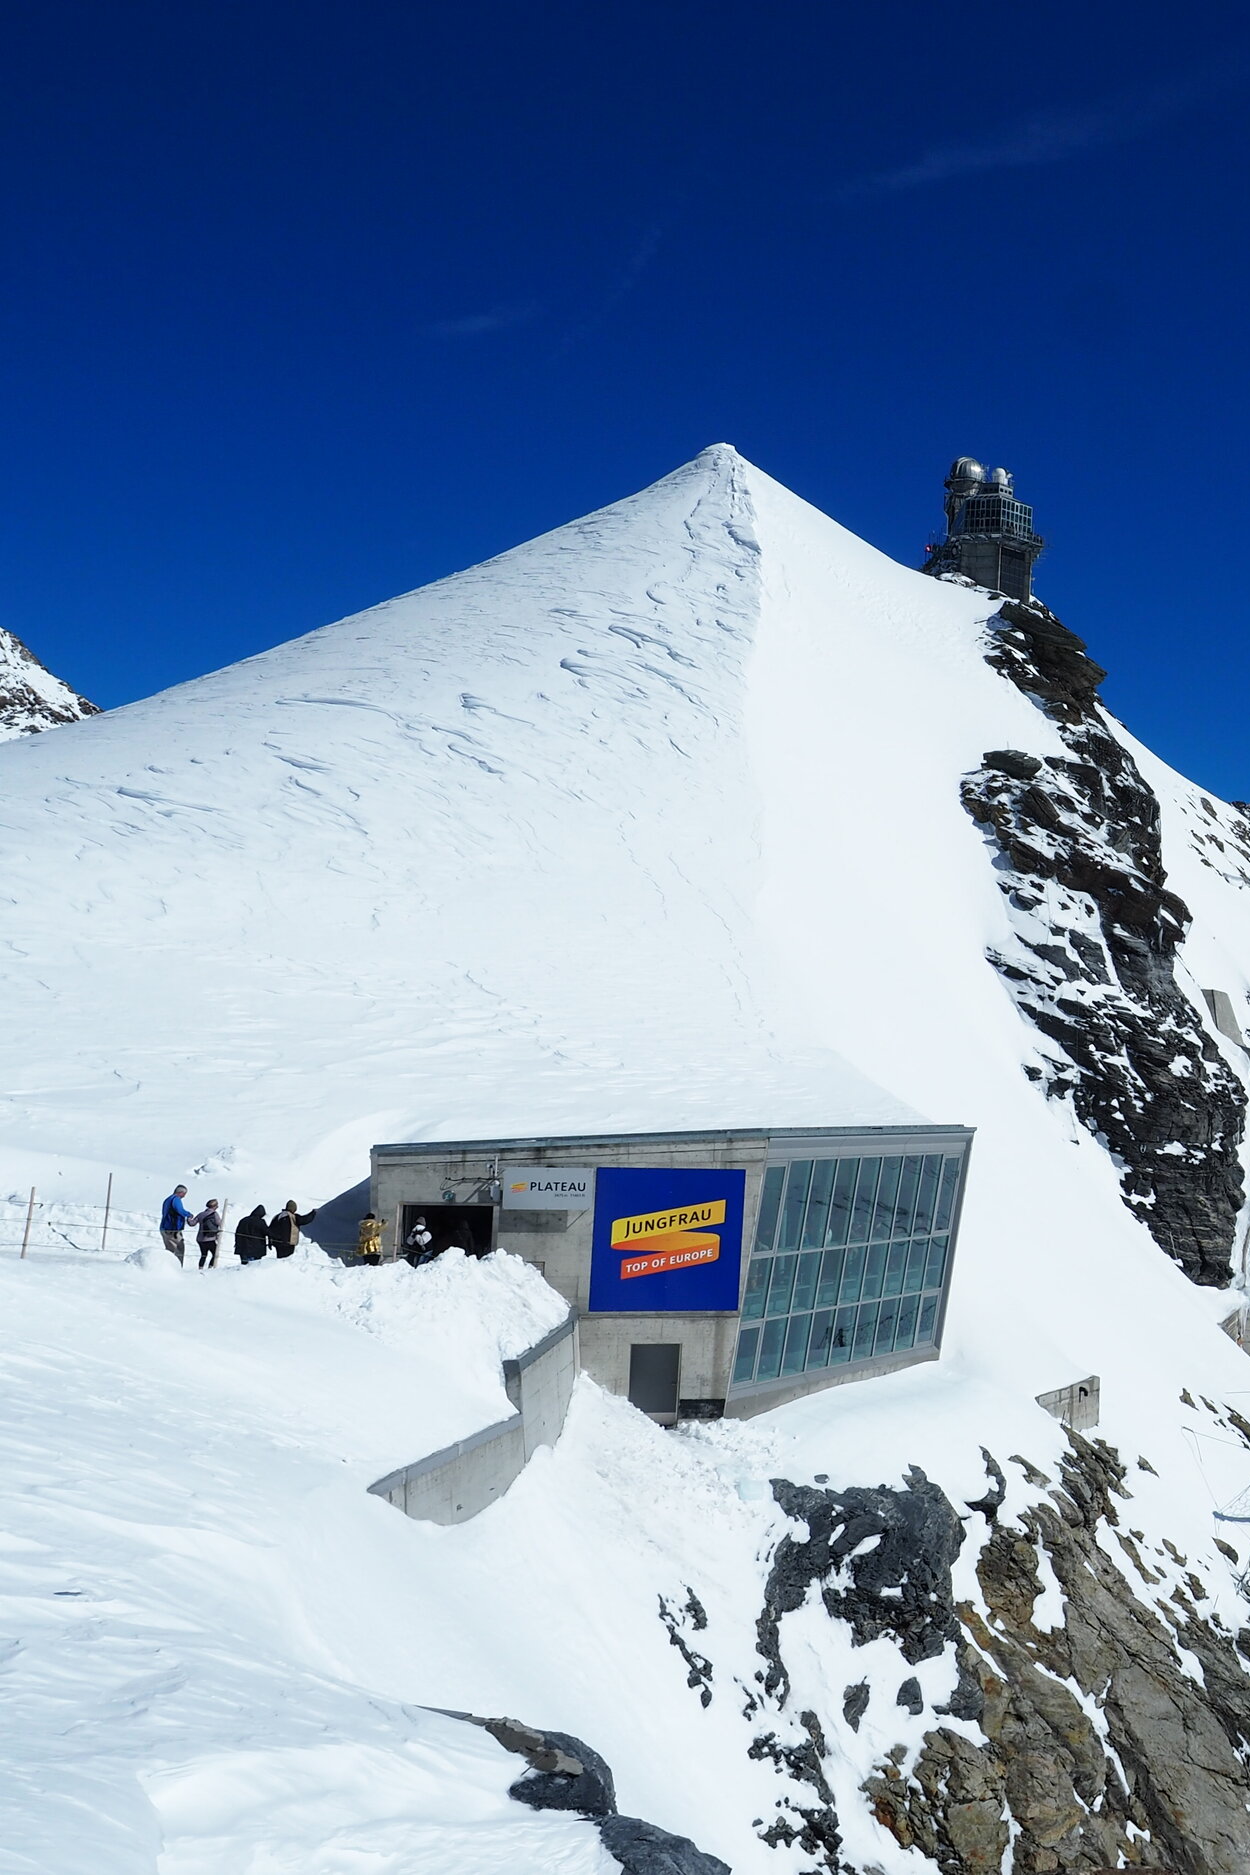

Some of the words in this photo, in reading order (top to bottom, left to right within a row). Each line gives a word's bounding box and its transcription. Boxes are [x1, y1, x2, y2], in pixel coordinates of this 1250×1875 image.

[530, 1181, 586, 1192] PLATEAU
[624, 1208, 711, 1238] JUNGFRAU
[625, 1261, 648, 1273] TOP
[651, 1257, 667, 1268] OF
[669, 1248, 713, 1265] EUROPE
